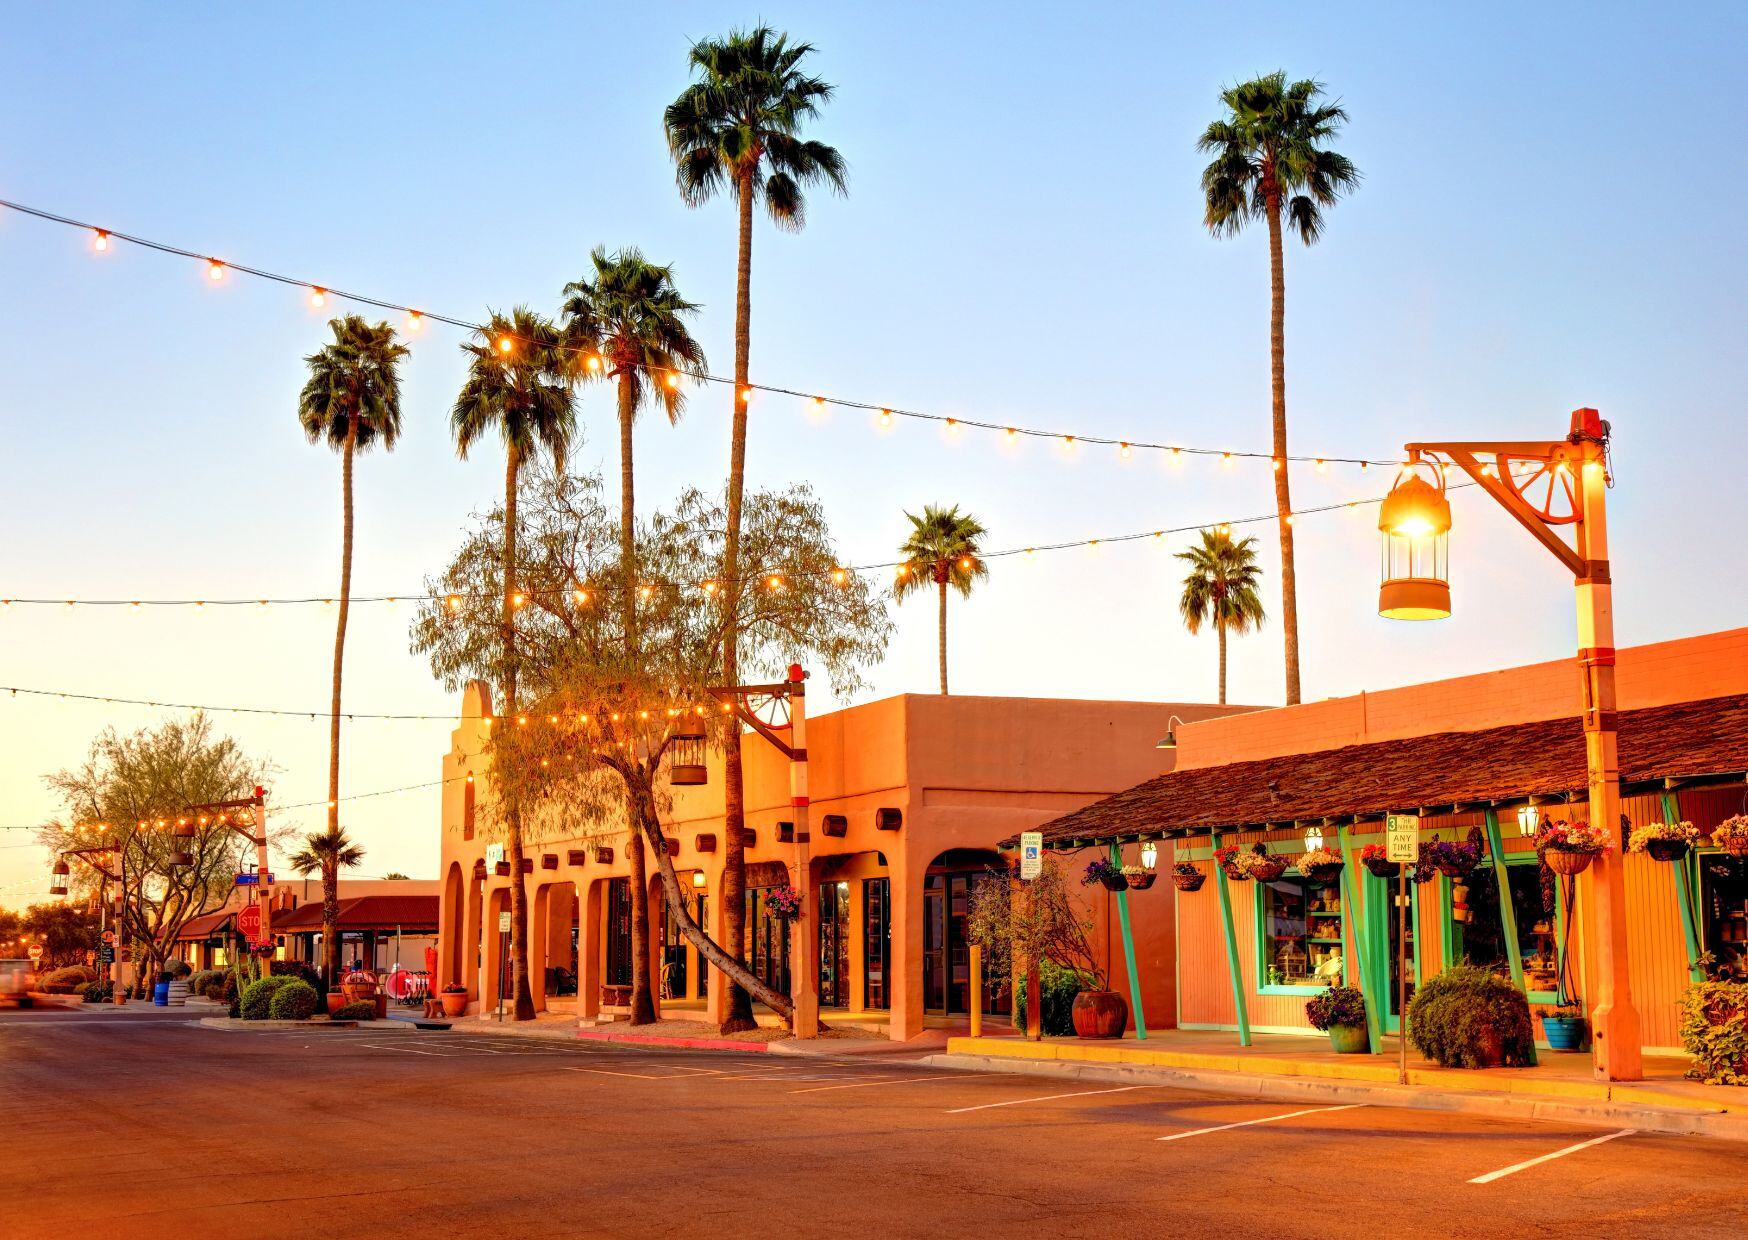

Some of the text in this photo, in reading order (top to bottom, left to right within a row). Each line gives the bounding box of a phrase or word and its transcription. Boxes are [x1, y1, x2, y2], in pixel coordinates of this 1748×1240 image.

[1389, 818, 1396, 831] 3
[1393, 843, 1412, 851] TIME
[241, 916, 260, 927] STO
